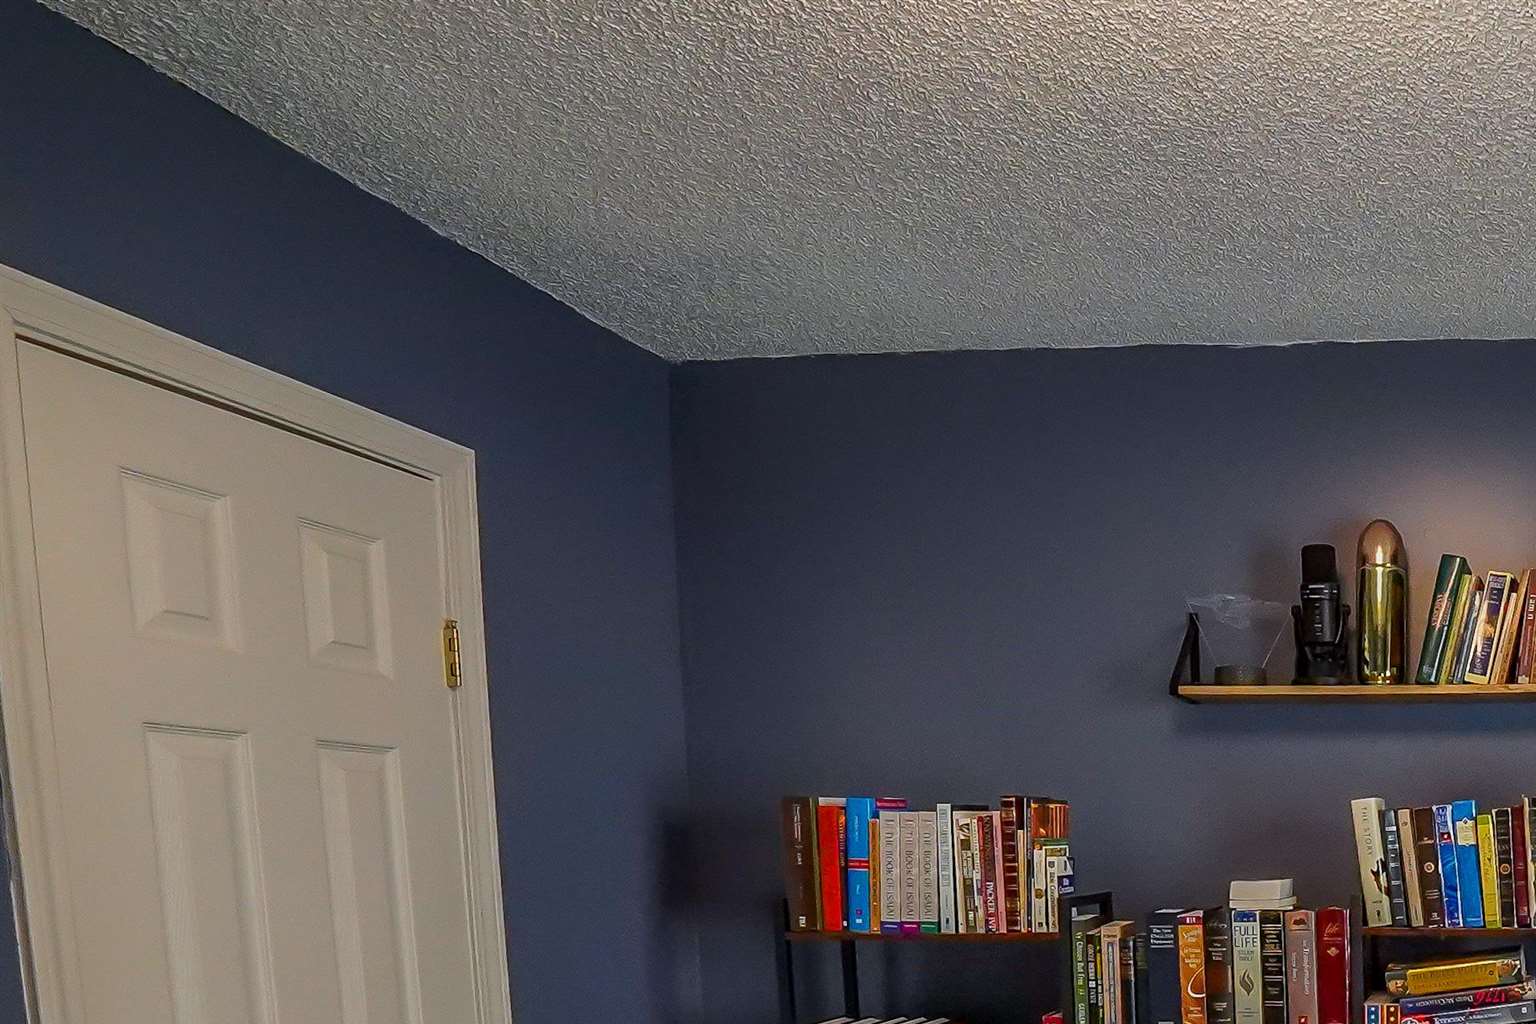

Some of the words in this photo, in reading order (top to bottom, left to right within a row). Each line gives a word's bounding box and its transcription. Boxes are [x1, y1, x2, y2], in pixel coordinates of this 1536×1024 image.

[1364, 828, 1373, 856] STORY
[886, 850, 896, 874] BOOK
[906, 850, 915, 874] BOOK
[923, 850, 933, 874] BOOK
[986, 882, 997, 914] PACKER
[1234, 926, 1258, 937] FULL
[1234, 937, 1258, 948] LIFE
